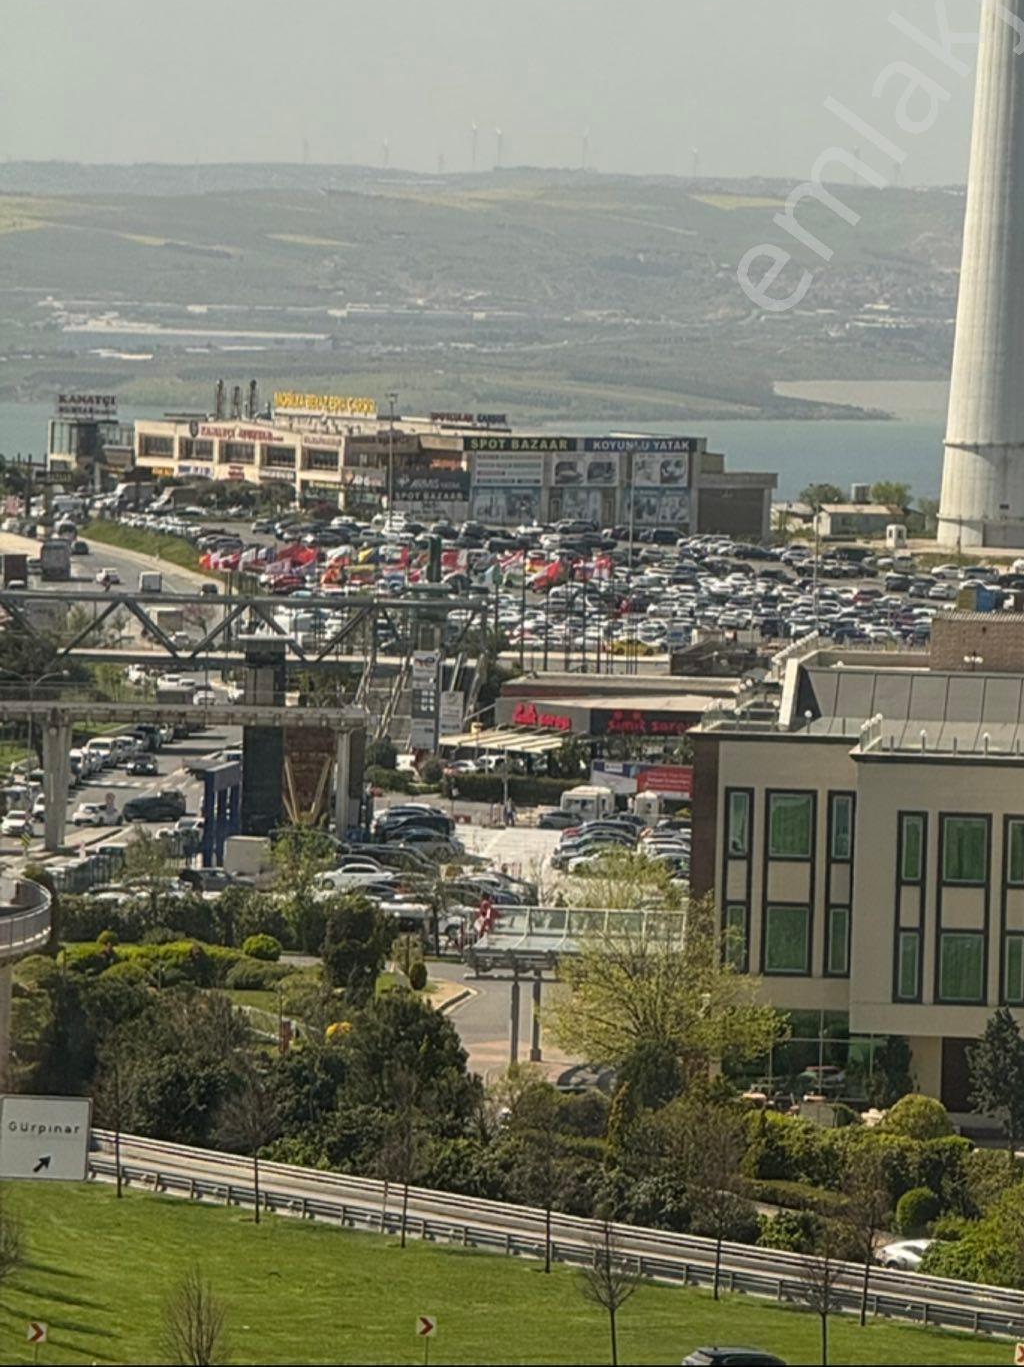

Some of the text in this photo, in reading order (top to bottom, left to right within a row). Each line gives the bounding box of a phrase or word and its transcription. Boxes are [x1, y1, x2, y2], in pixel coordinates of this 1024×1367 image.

[59, 394, 116, 407] KANATÇI
[471, 438, 568, 450] SPOT BAZAAR
[654, 441, 690, 452] YATAK
[394, 491, 464, 500] SPOT BAZAAR
[607, 710, 646, 732] simit
[8, 1120, 81, 1135] Gürpınar
